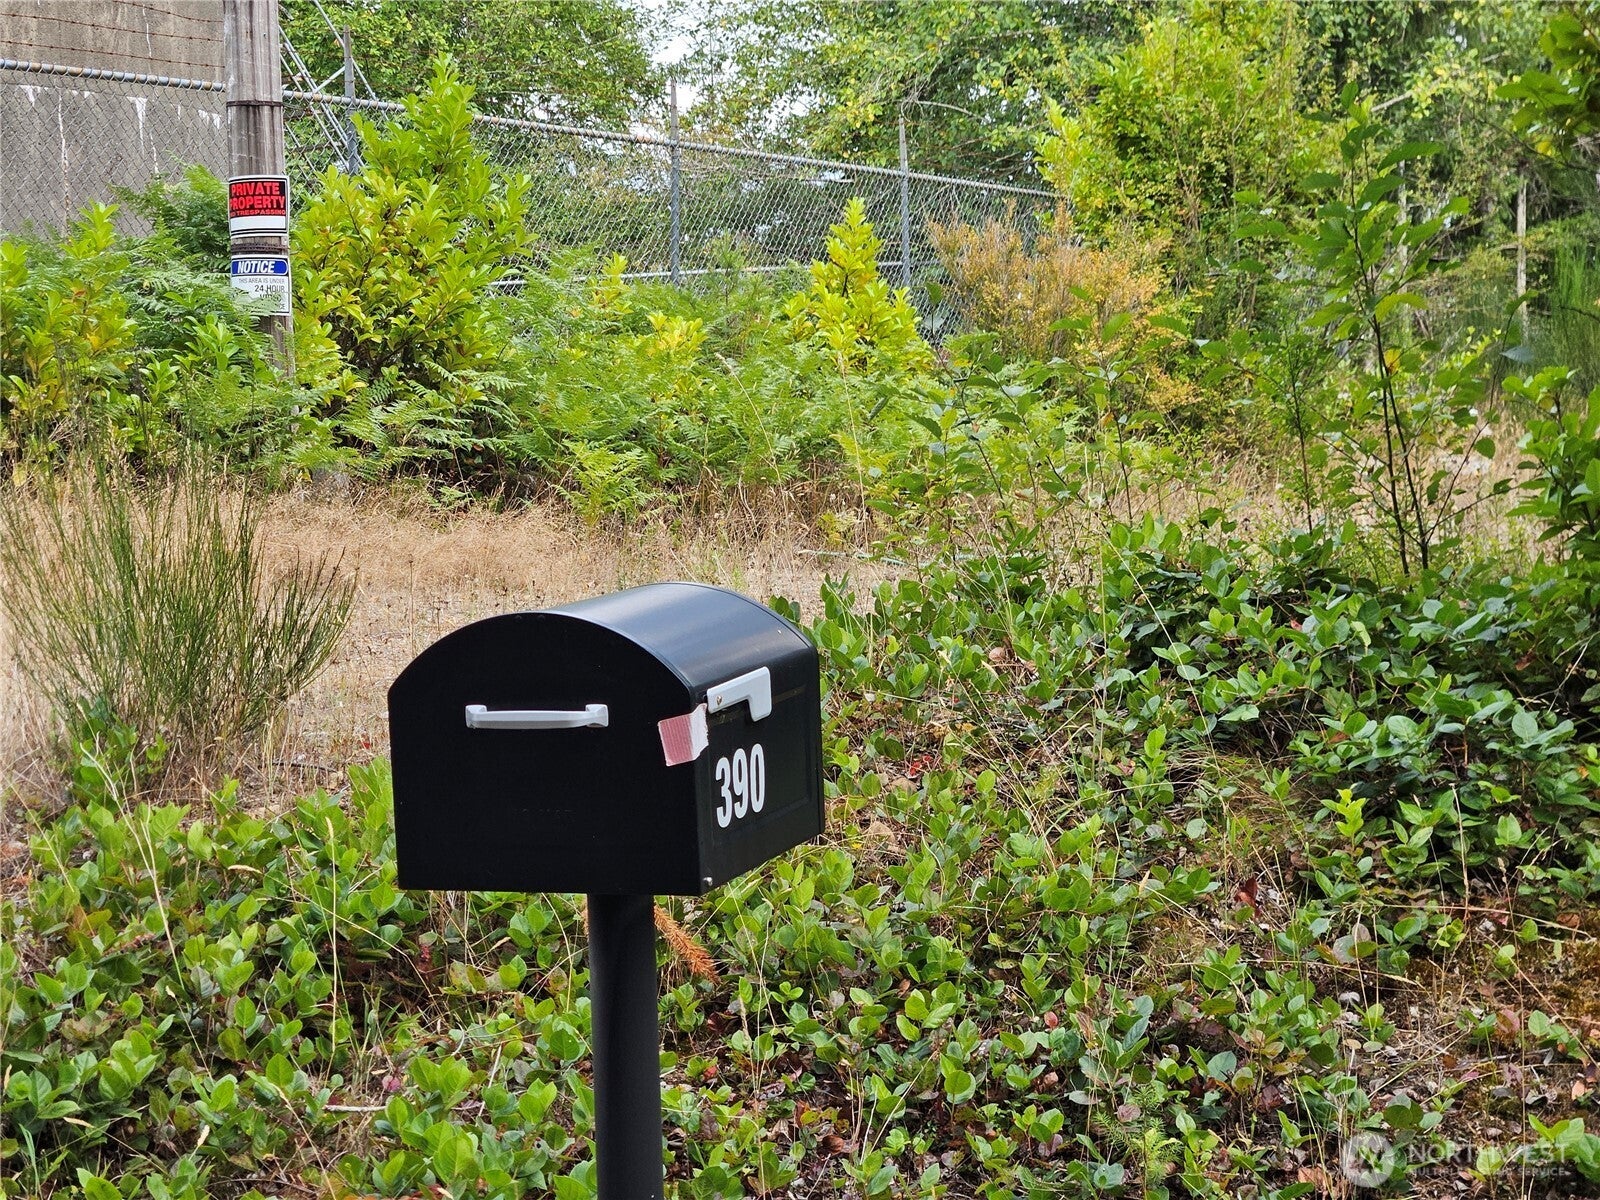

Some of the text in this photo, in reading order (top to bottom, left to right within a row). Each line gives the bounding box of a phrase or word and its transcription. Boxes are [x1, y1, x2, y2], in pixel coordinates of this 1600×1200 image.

[231, 182, 280, 196] PRIVATE
[229, 196, 285, 210] PROPERTY
[237, 260, 276, 274] NOTICE
[254, 284, 285, 294] 24 HOUR
[715, 743, 766, 828] 390
